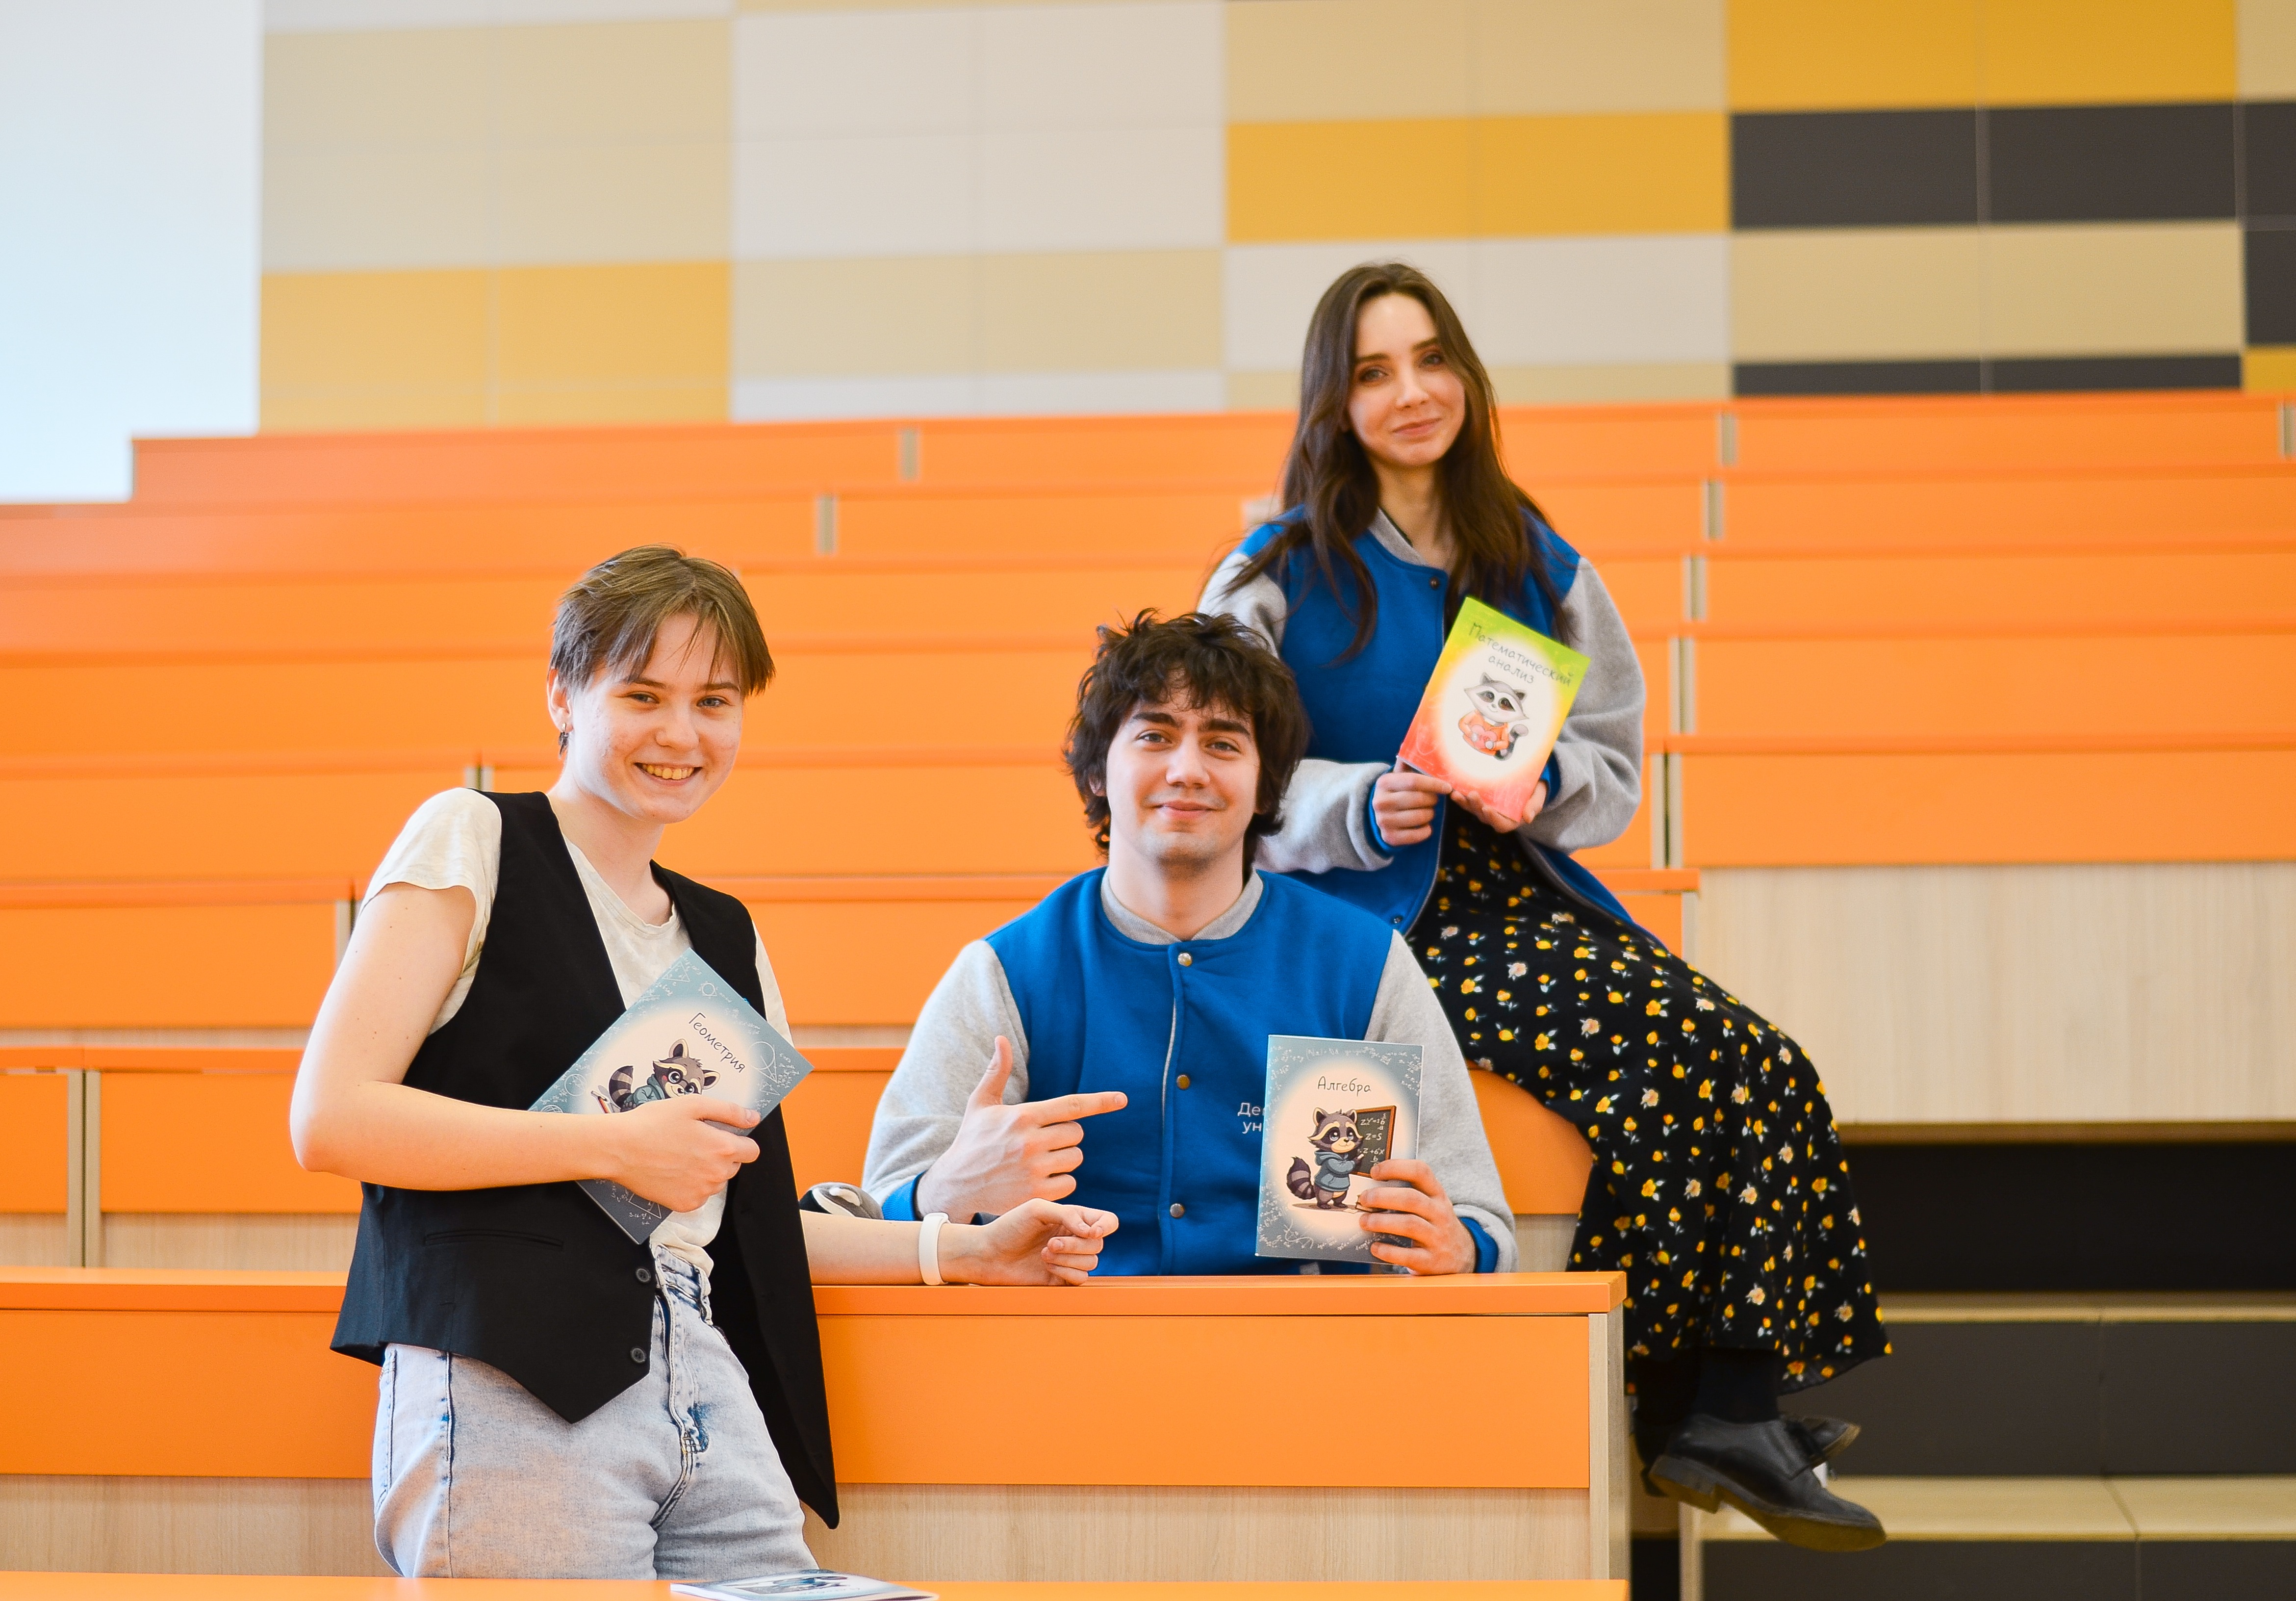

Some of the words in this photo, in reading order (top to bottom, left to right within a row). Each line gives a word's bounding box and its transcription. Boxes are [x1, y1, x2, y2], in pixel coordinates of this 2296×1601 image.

[1469, 622, 1573, 686] Математический
[1488, 655, 1534, 684] анализ
[689, 1012, 745, 1073] Геометрия
[1318, 1076, 1372, 1097] Алгебра
